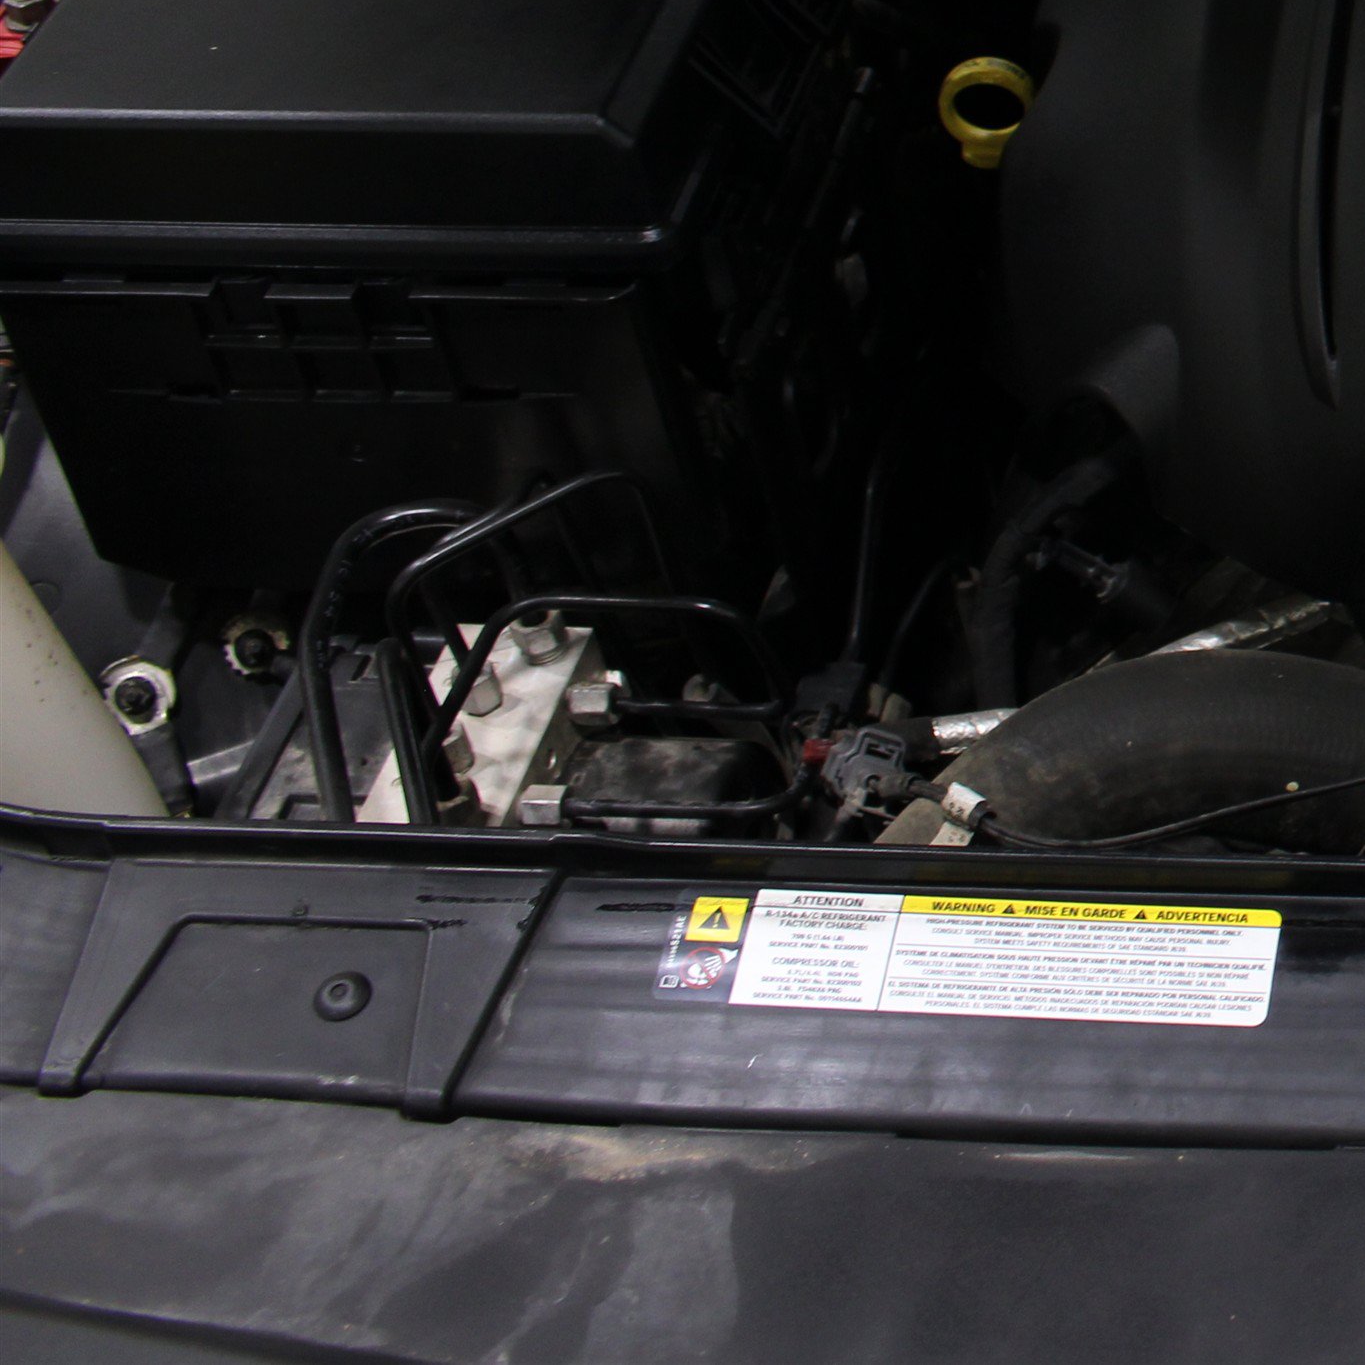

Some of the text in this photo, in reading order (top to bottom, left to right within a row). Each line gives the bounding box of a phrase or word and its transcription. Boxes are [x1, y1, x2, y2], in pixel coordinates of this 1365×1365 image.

[793, 895, 865, 907] ATTENTION
[931, 901, 996, 913] WARNING
[821, 912, 886, 921] REFRIGERANT
[1024, 904, 1127, 919] MISE EN GARDE
[1156, 910, 1249, 923] ADVERTENCIA
[779, 919, 823, 928] FACTORY
[772, 957, 839, 966] COMPRESSOR
